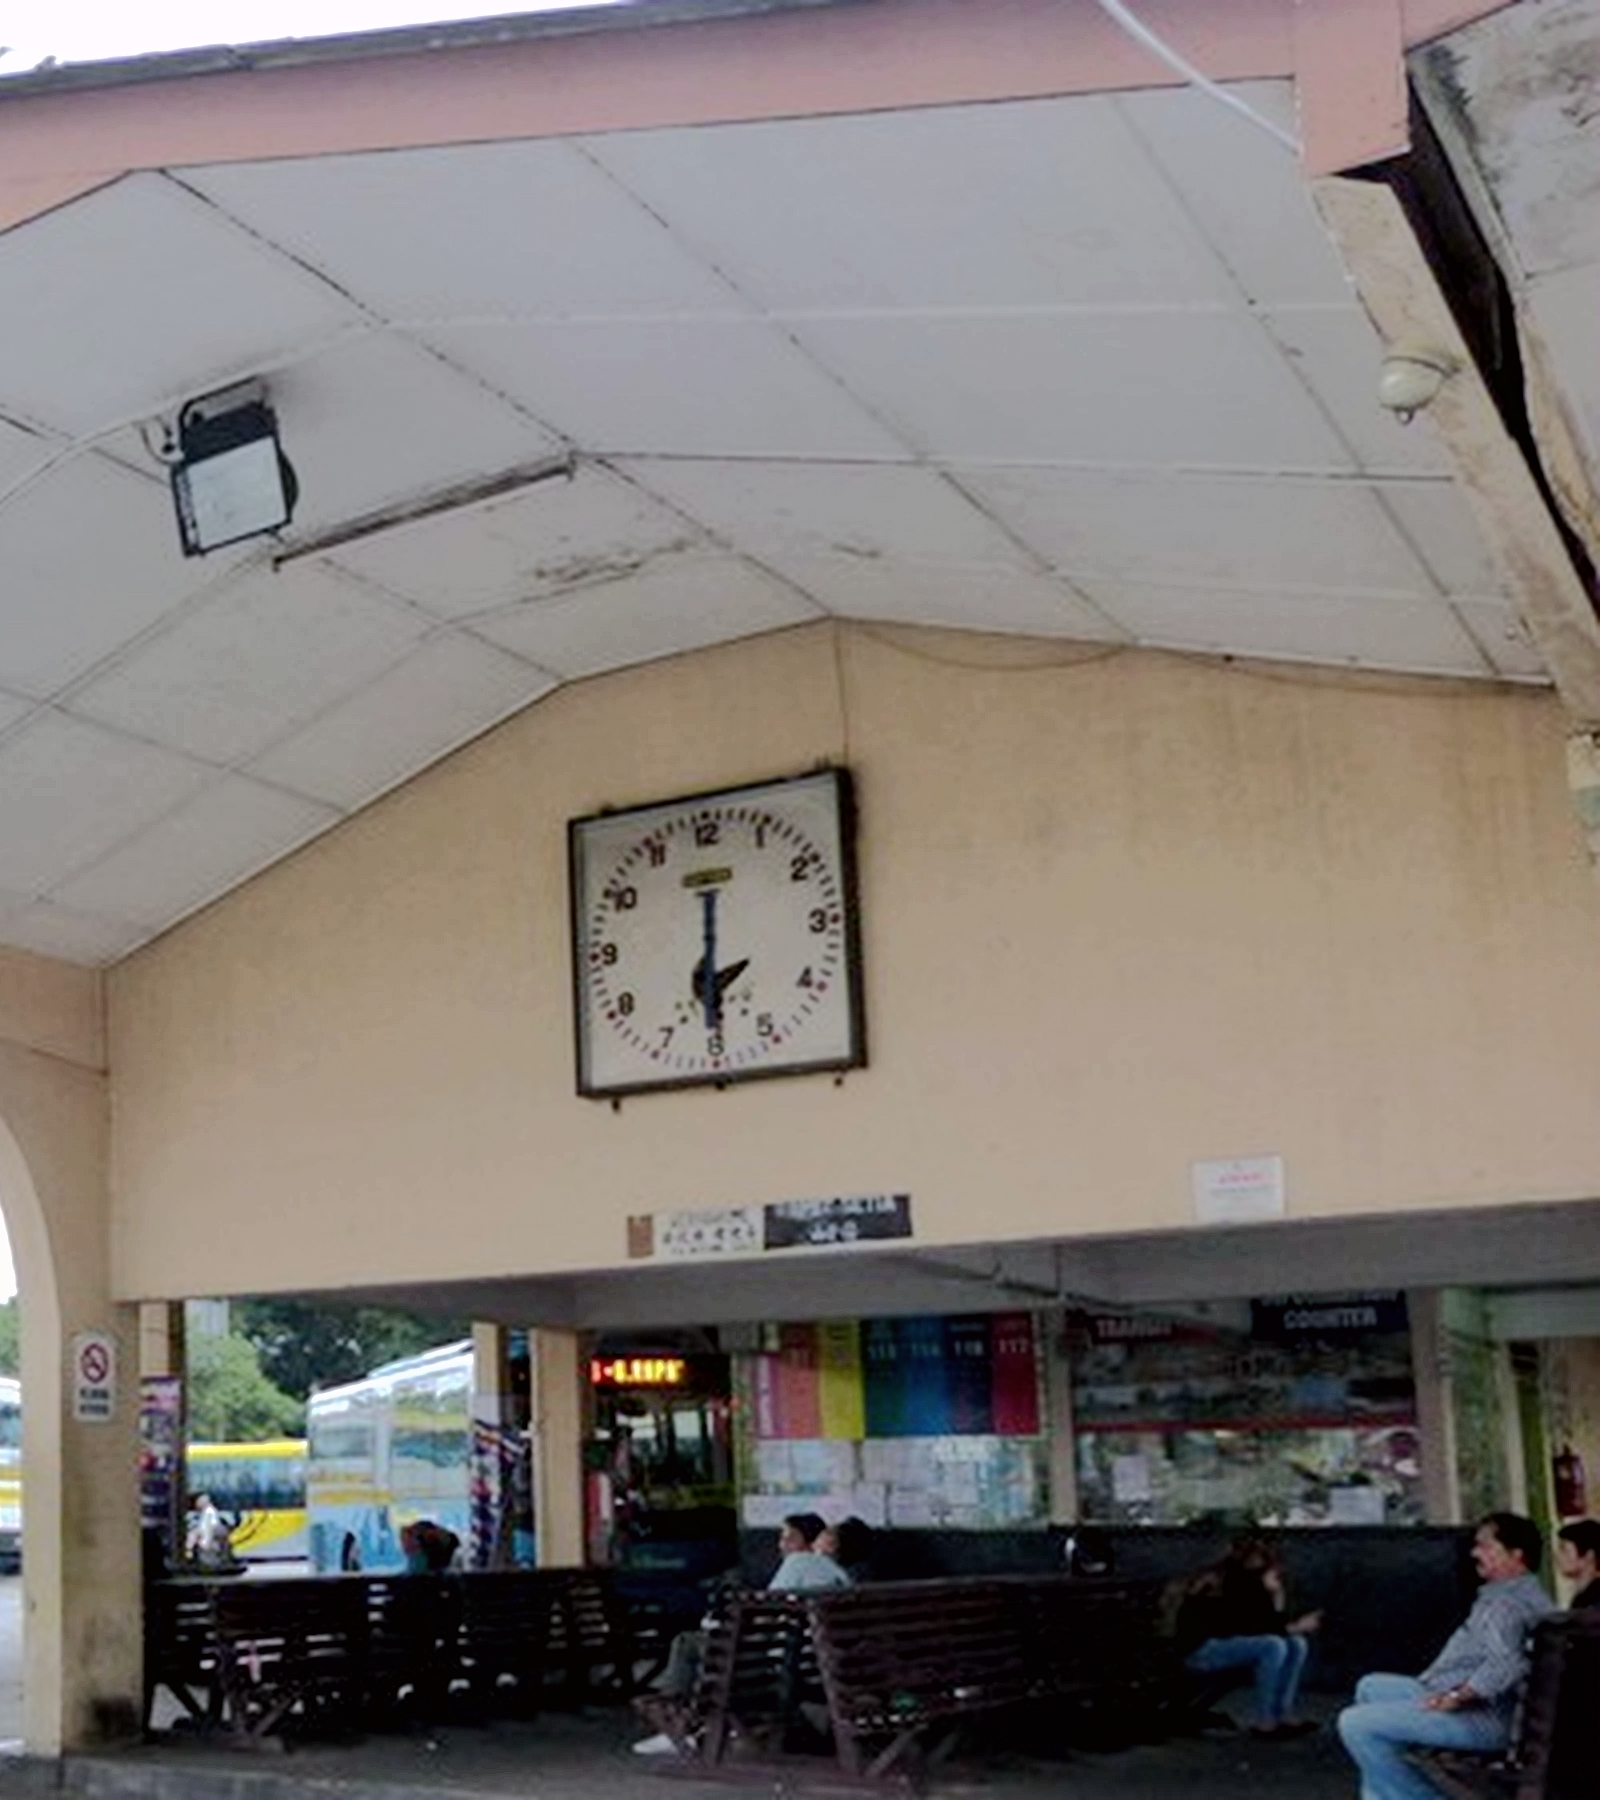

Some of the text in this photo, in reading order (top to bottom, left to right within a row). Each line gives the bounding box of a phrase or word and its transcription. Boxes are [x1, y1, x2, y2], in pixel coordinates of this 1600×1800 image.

[694, 821, 719, 848] 12
[754, 822, 766, 849] 1
[647, 841, 666, 868] 11
[790, 854, 809, 882] 2
[612, 885, 638, 912] 10
[808, 907, 827, 934] 3
[601, 942, 618, 966] 9
[795, 965, 813, 989] 4
[618, 991, 635, 1017] 8
[658, 1025, 675, 1049] 7
[756, 1011, 774, 1037] 5
[706, 1034, 725, 1057] 6
[1282, 1305, 1379, 1331] COUNTER
